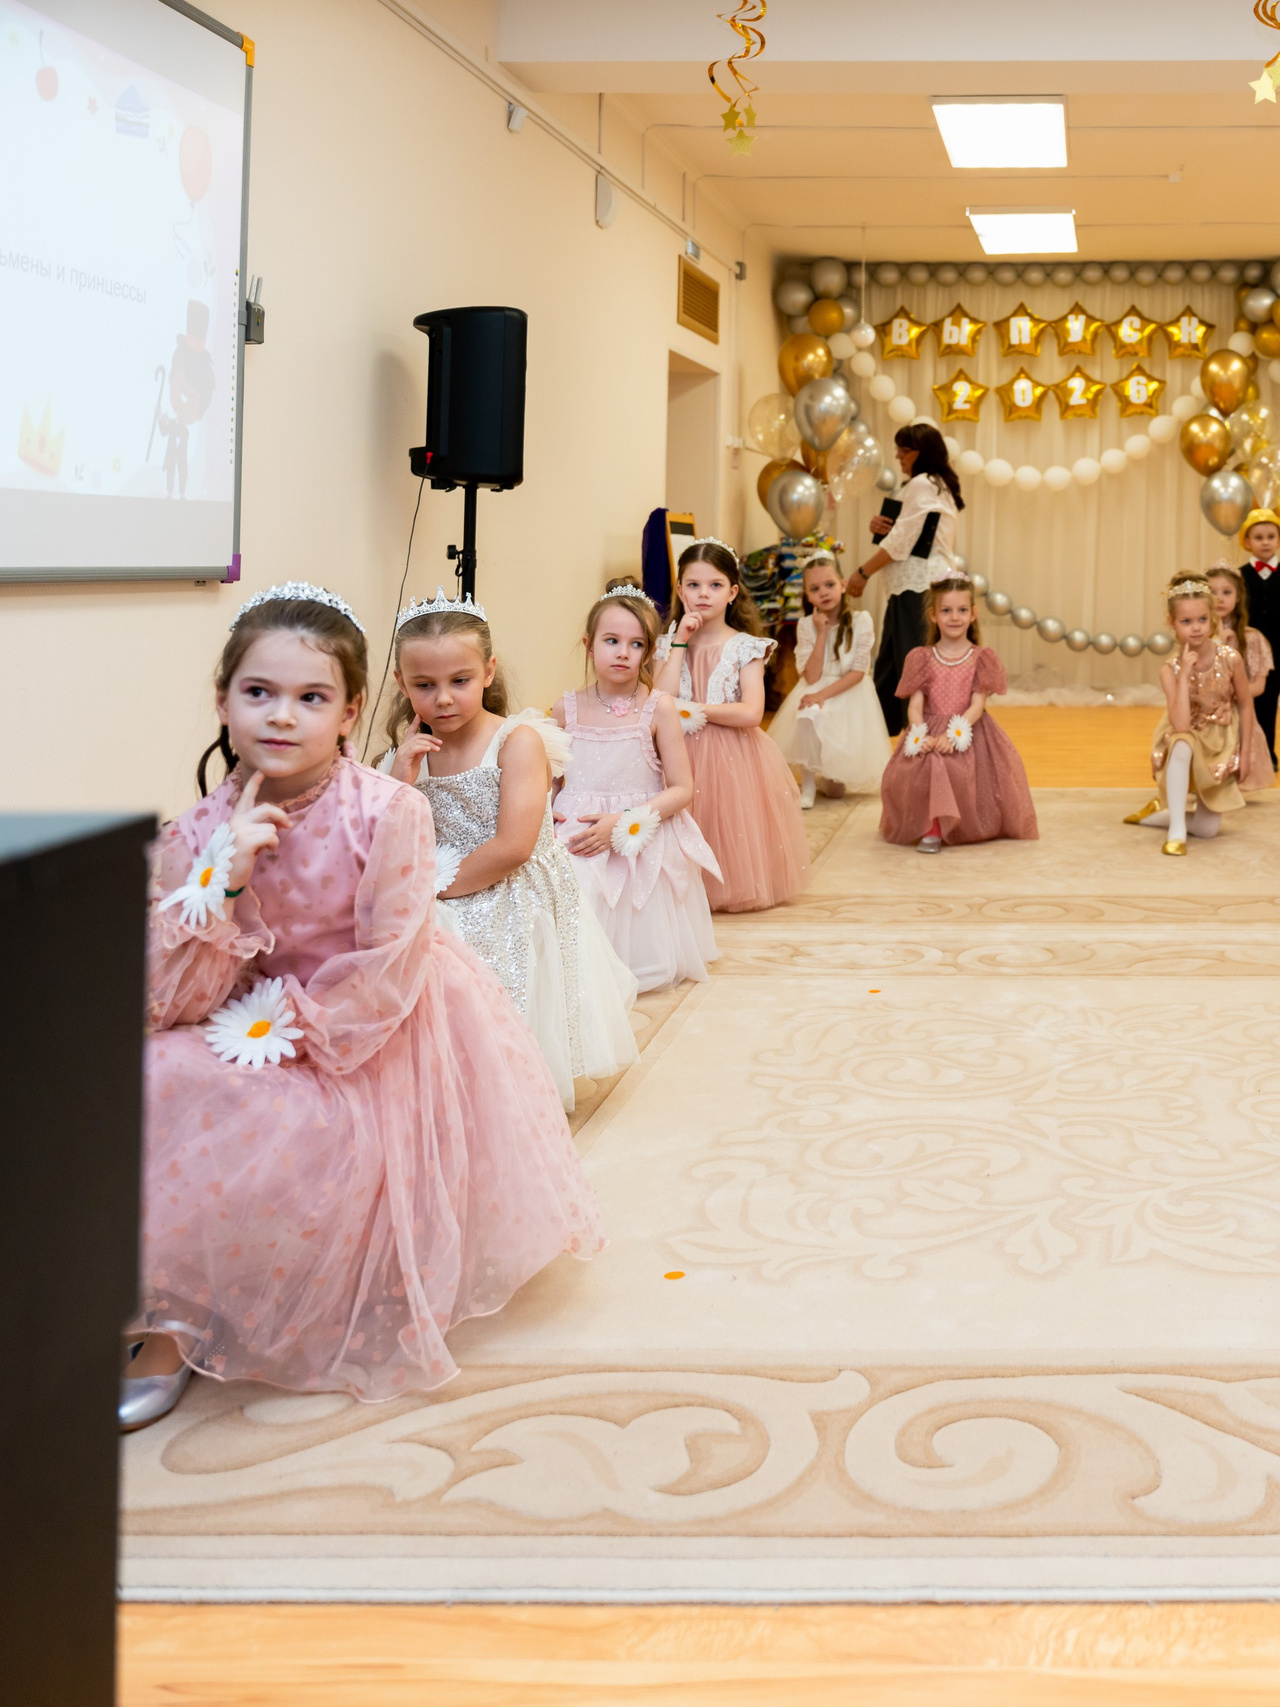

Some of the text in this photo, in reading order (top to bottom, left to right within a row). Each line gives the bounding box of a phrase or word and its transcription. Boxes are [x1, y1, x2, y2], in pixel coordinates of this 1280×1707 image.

[56, 263, 65, 283] и
[70, 267, 146, 304] принцессы
[952, 376, 1148, 410] 2026
